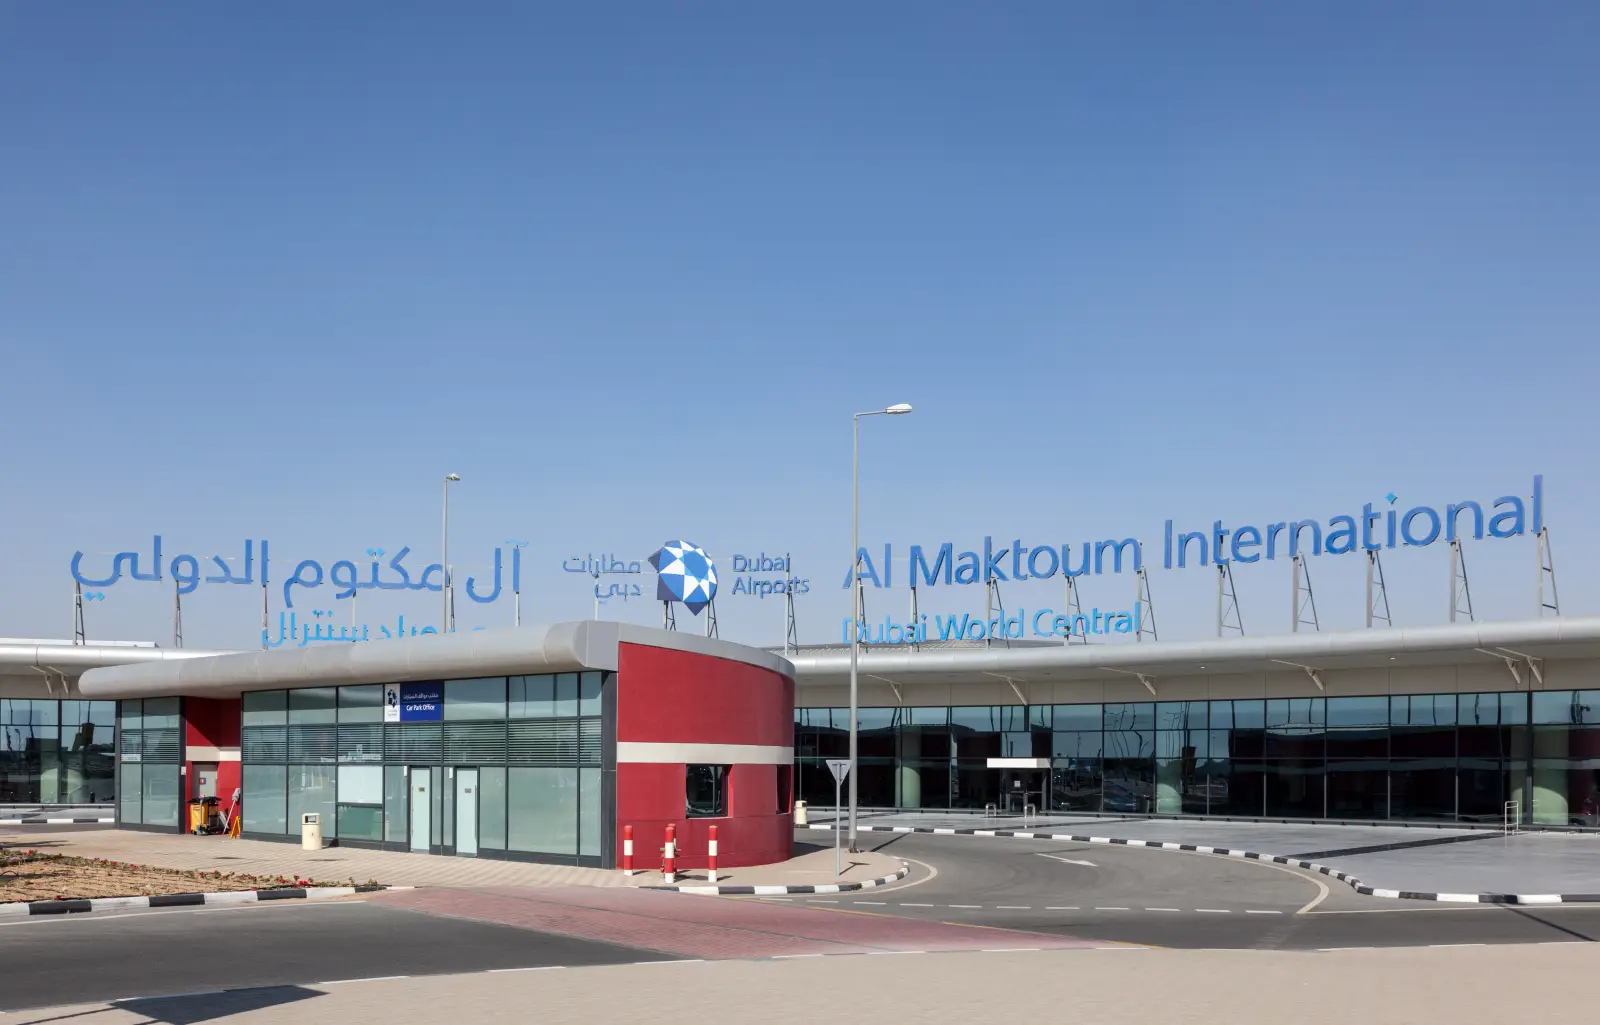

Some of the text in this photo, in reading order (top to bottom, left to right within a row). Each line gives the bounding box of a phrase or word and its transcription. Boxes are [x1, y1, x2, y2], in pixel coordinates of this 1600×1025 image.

[842, 474, 1544, 589] Al Maktoum International
[71, 535, 529, 608] آل مكتوم الدولي
[562, 553, 642, 578] مطارات
[732, 553, 790, 573] Dubai
[594, 581, 642, 603] دبي
[732, 575, 810, 599] Airports
[261, 609, 369, 648] سنترال
[842, 602, 1141, 645] Dubai World Central
[422, 703, 435, 711] Office
